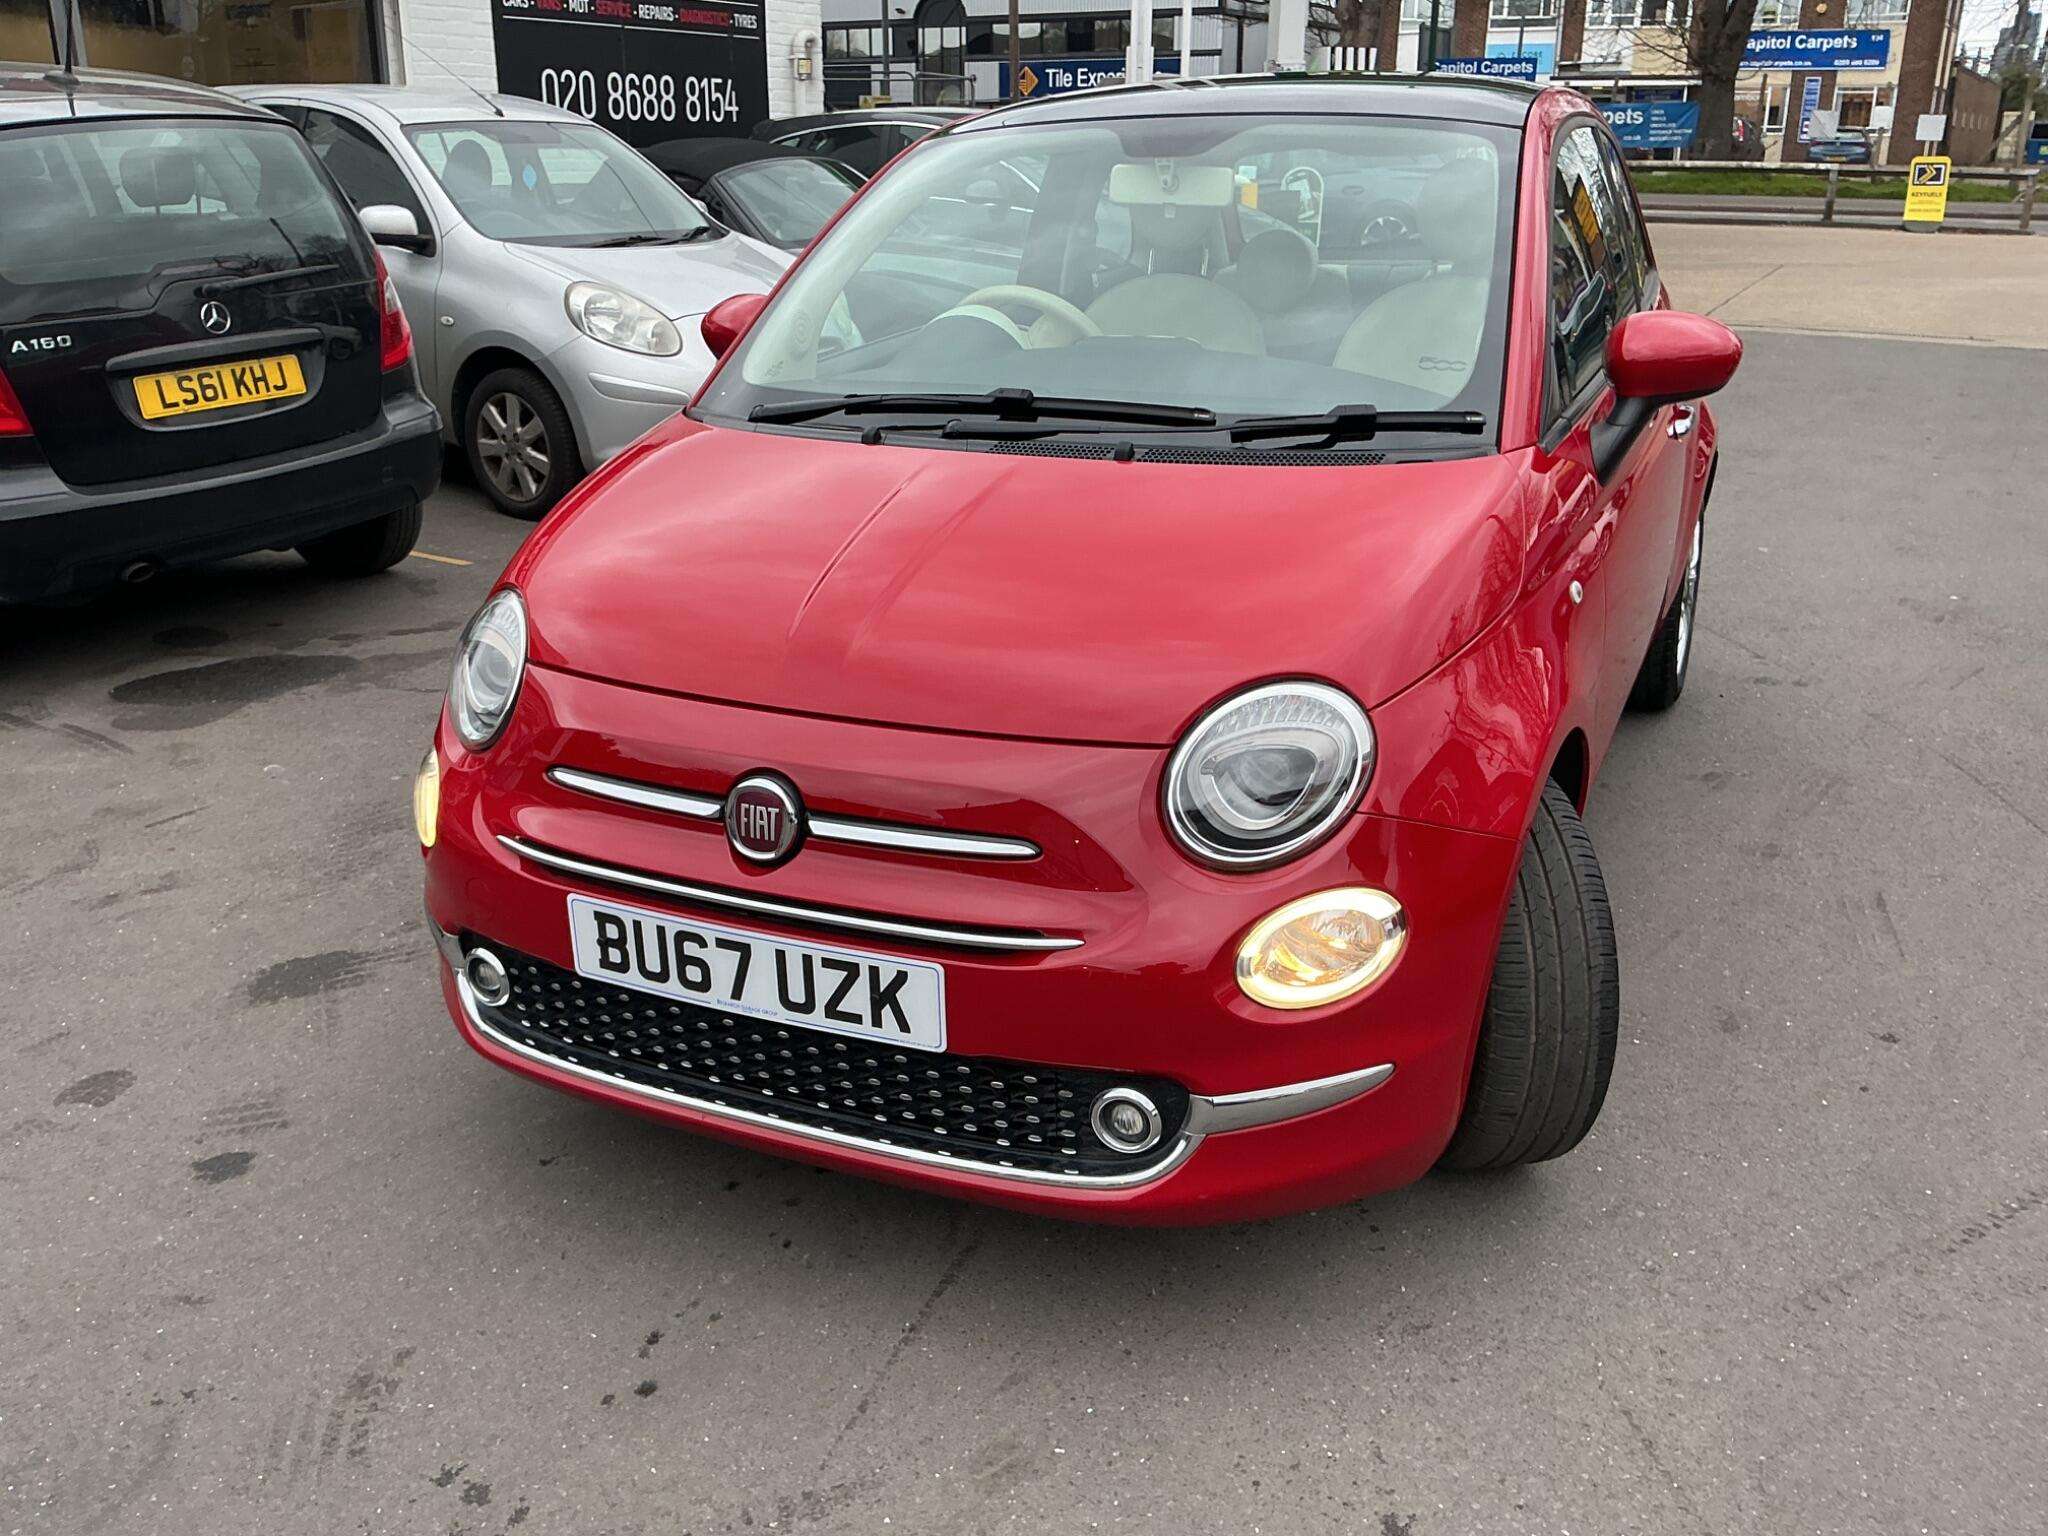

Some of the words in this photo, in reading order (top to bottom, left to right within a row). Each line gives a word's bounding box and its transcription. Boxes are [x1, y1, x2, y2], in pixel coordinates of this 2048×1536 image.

[503, 0, 529, 8] CARS
[569, 0, 588, 13] MOT
[596, 0, 632, 18] SERVICE
[638, 4, 674, 21] REPAIRS
[680, 8, 729, 27] DIAGNOSTICS
[733, 13, 758, 29] TYRES
[1746, 35, 1791, 52] apitol
[1795, 34, 1858, 51] Carpets
[1045, 68, 1072, 88] Tile
[1481, 60, 1534, 75] Carpets
[541, 68, 596, 120] 020
[607, 72, 676, 122] 8688
[685, 76, 739, 122] 8154
[1603, 107, 1643, 125] pets
[156, 370, 228, 409] LS61
[231, 361, 287, 397] KHJ
[741, 803, 779, 841] FIAT
[593, 910, 751, 1002] BU67
[774, 948, 911, 1034] UZK
